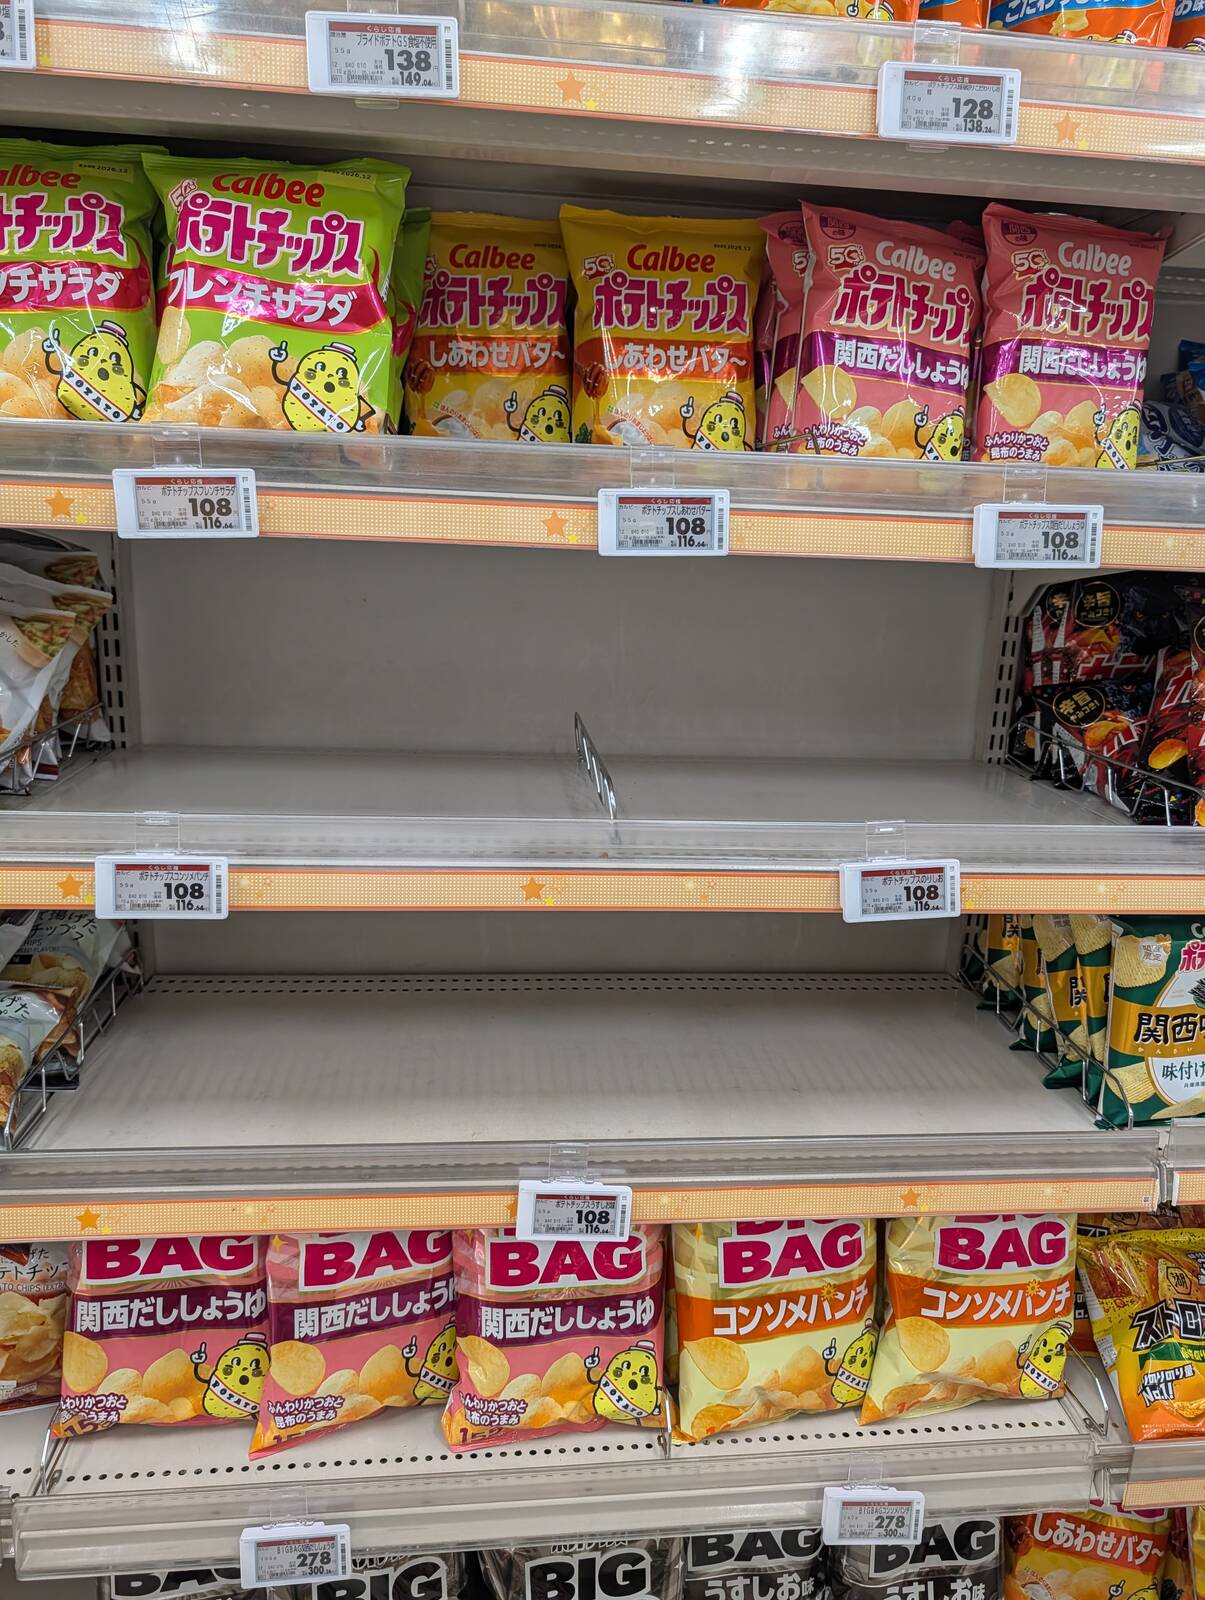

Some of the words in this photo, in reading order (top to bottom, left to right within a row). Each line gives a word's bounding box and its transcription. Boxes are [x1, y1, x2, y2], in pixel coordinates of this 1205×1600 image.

[384, 49, 432, 71] 138
[399, 72, 432, 87] 149.04
[953, 98, 993, 119] 128
[0, 164, 82, 189] lbee
[211, 172, 326, 208] Calbee
[176, 191, 364, 278] ポテトチップス
[449, 244, 536, 270] Calbee
[626, 244, 716, 273] Calbee
[875, 240, 957, 282] Calbee
[1057, 241, 1133, 276] Calbee
[0, 266, 125, 304] チサラダ
[168, 267, 358, 326] フレンチサラダ
[418, 271, 567, 329] ポテトチップス
[593, 271, 750, 335] ポテトチップス
[189, 498, 232, 517] 108
[666, 517, 706, 535] 108
[1041, 532, 1079, 548] 108
[164, 883, 204, 900] 108
[904, 885, 939, 901] 108
[576, 1210, 610, 1224] 108
[86, 1236, 256, 1280] BAG
[304, 1231, 453, 1287] BAG
[489, 1236, 643, 1287] BAG
[722, 1222, 863, 1284] BAG
[937, 1221, 1067, 1271] BAG
[17, 1284, 41, 1293] CHIPS
[920, 1281, 1071, 1321] コンソメパンチ
[76, 1289, 267, 1332] 関西だししょうゆ
[481, 1297, 655, 1340] 関西だししょうゆ
[713, 1279, 868, 1336] コンソメパンチ
[211, 1379, 258, 1411] POTATO
[268, 1396, 344, 1414] ふんわりかつおと
[602, 1380, 645, 1417] POTATO
[275, 1410, 336, 1428] 昆布のうまみ
[875, 1516, 905, 1529] 278
[297, 1551, 331, 1568] 278
[691, 1530, 823, 1566] BAG
[874, 1520, 996, 1573] BAG
[530, 1552, 647, 1600] BIG
